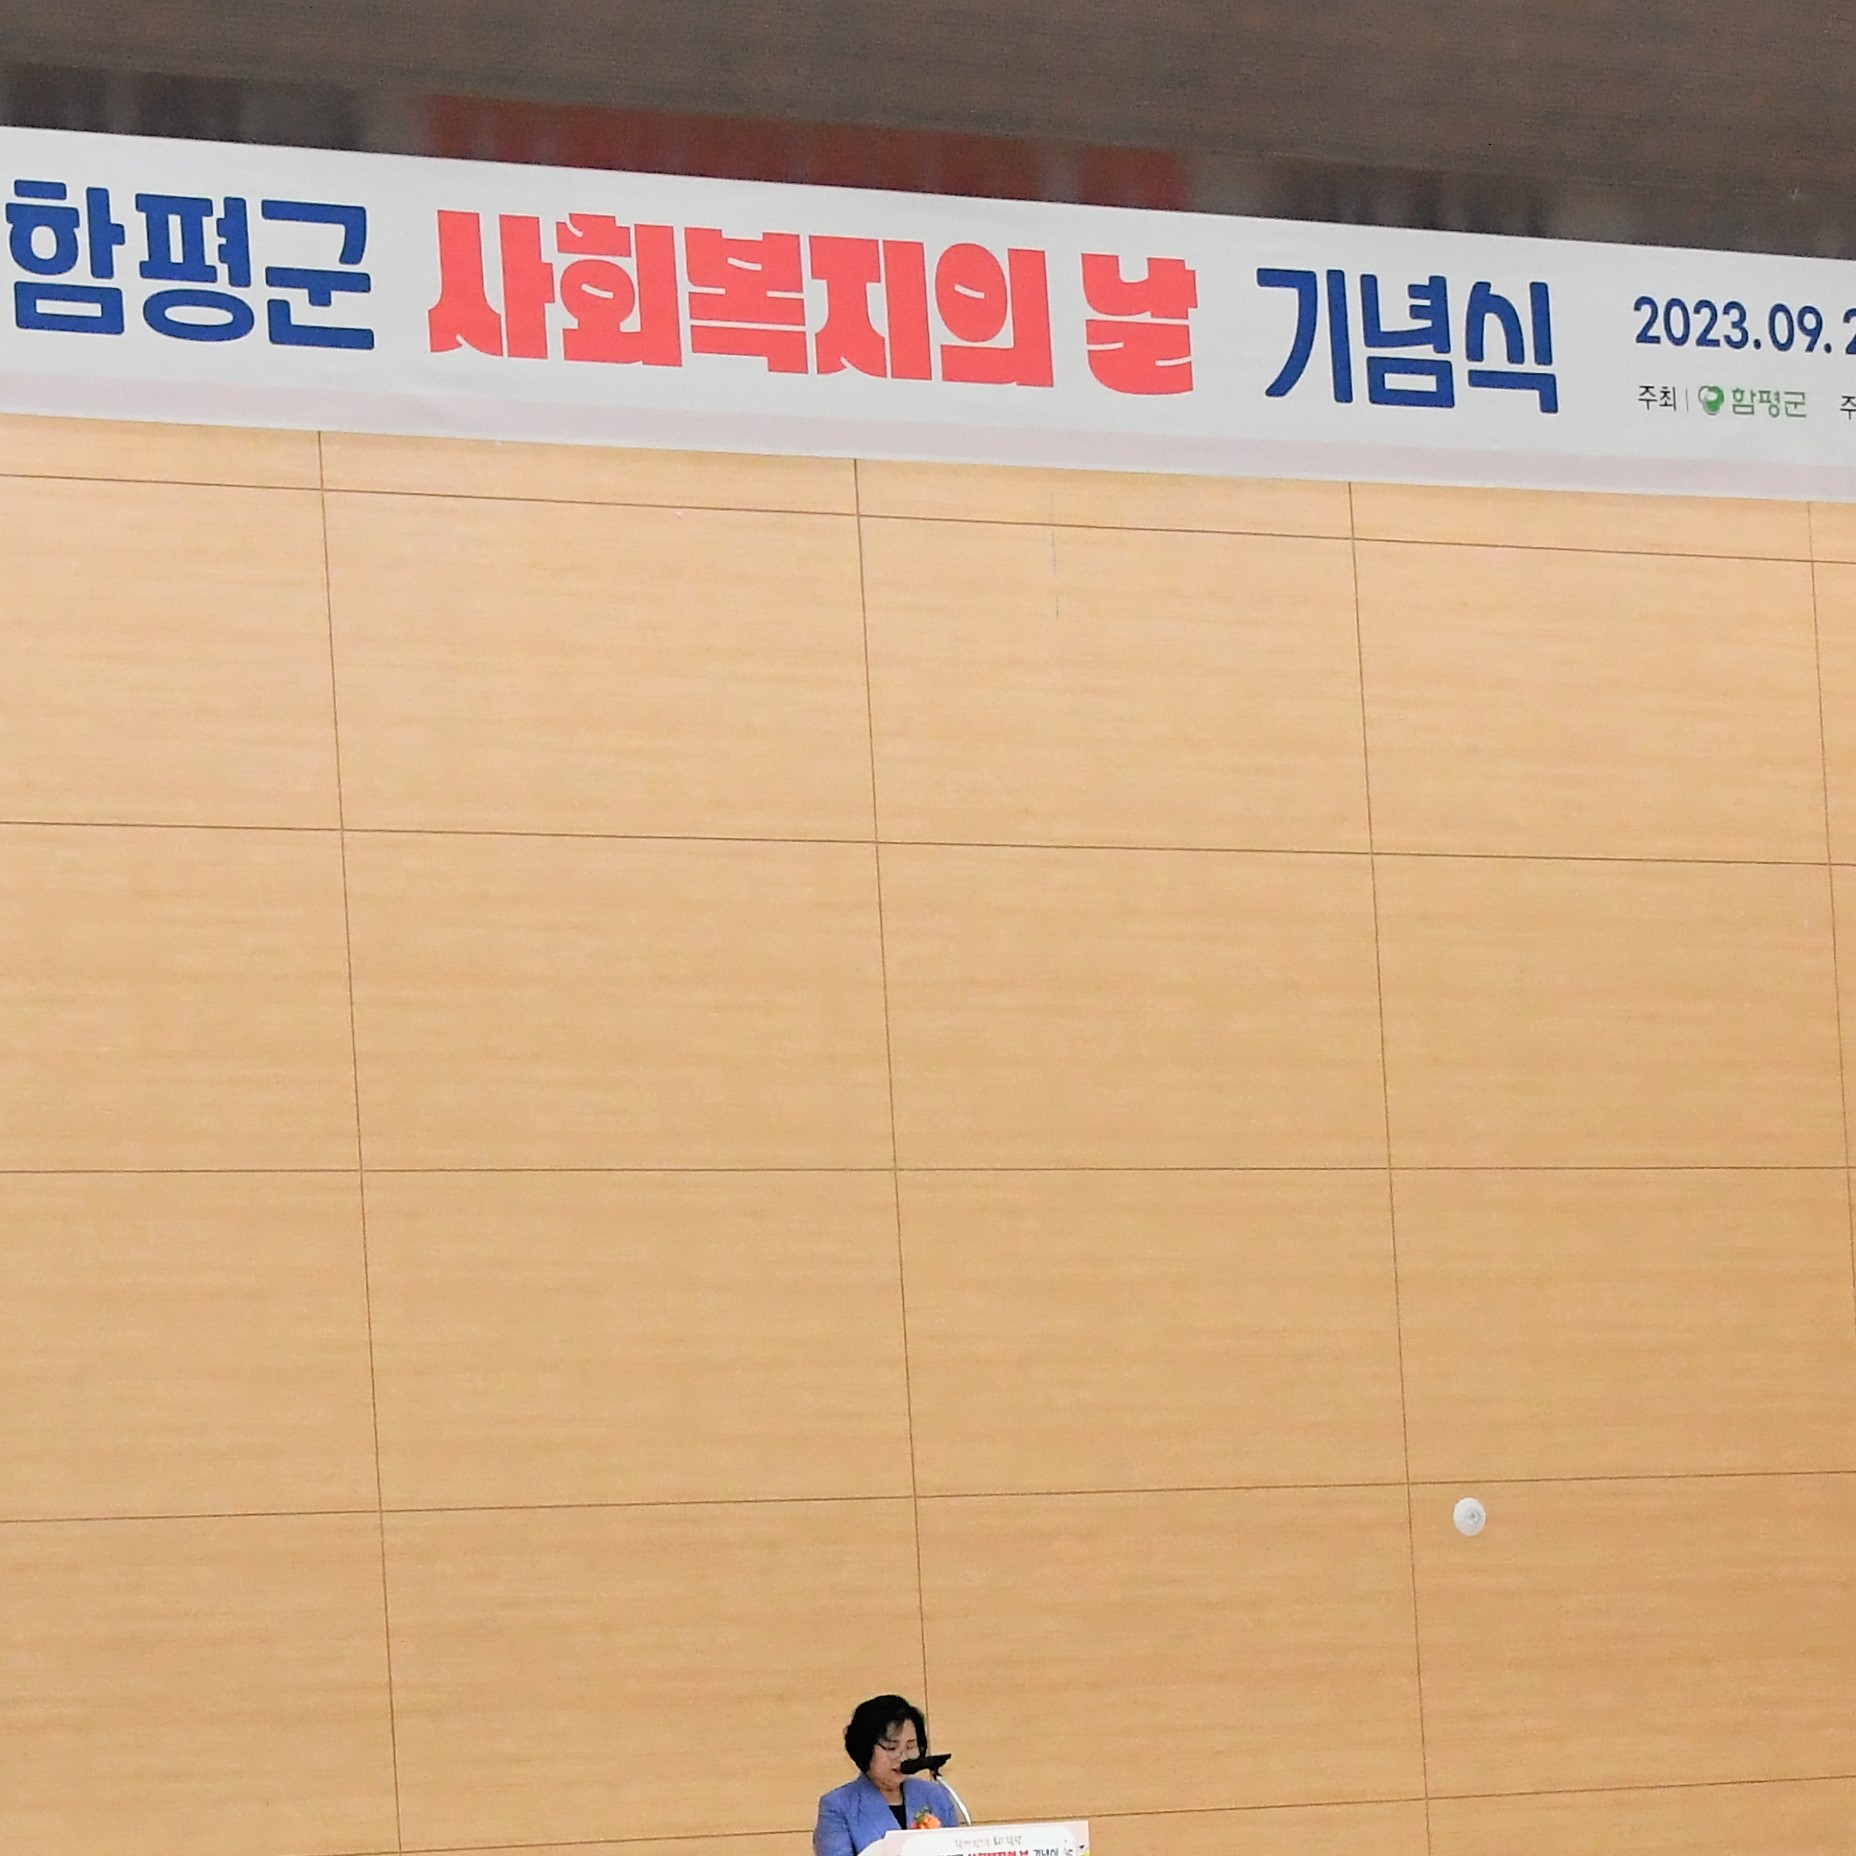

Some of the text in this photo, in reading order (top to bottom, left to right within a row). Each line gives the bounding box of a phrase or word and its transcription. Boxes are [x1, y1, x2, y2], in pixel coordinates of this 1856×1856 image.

[5, 179, 374, 350] 함평군
[427, 208, 1054, 389] 사회복지의
[1082, 252, 1198, 397] 날
[1256, 268, 1558, 414] 기념식
[1638, 384, 1677, 412] 주최
[1731, 387, 1807, 419] 함평군
